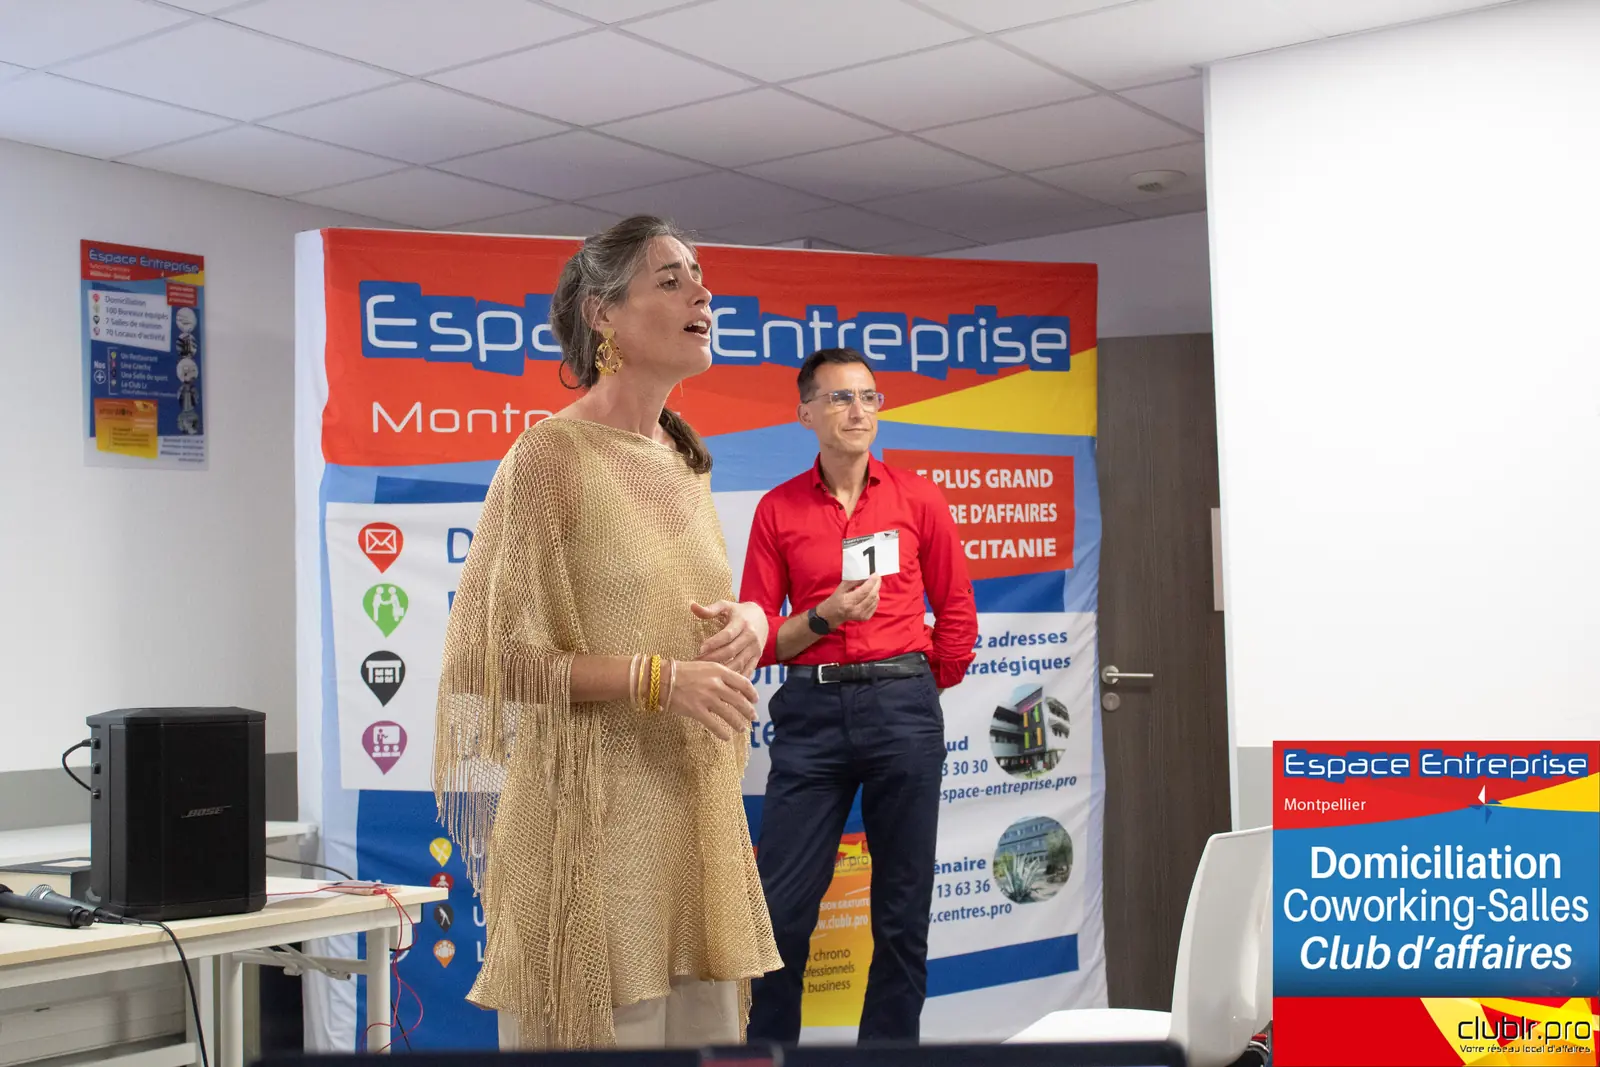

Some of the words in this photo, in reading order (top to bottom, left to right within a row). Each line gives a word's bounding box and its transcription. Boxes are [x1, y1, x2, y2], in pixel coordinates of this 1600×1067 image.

[89, 249, 137, 265] Espace
[140, 255, 199, 273] Entreprise
[710, 307, 1067, 372] Entreprise
[932, 469, 981, 489] PLUS
[985, 468, 1054, 489] GRAND
[970, 502, 1058, 524] D'AFFAIRES
[961, 537, 1057, 560] CITANIE
[863, 545, 875, 576] 1
[987, 628, 1068, 648] adresses
[965, 654, 1072, 676] tratégiques
[946, 735, 969, 752] ud
[952, 760, 969, 775] 30
[972, 758, 988, 774] 30
[940, 775, 1078, 804] space-entreprise.pro
[184, 805, 228, 818] BOSE
[937, 883, 951, 899] 13
[955, 880, 971, 896] 63
[974, 878, 991, 895] 36
[813, 948, 851, 962] chrono
[803, 960, 855, 978] ofessionnels
[807, 980, 851, 993] business
